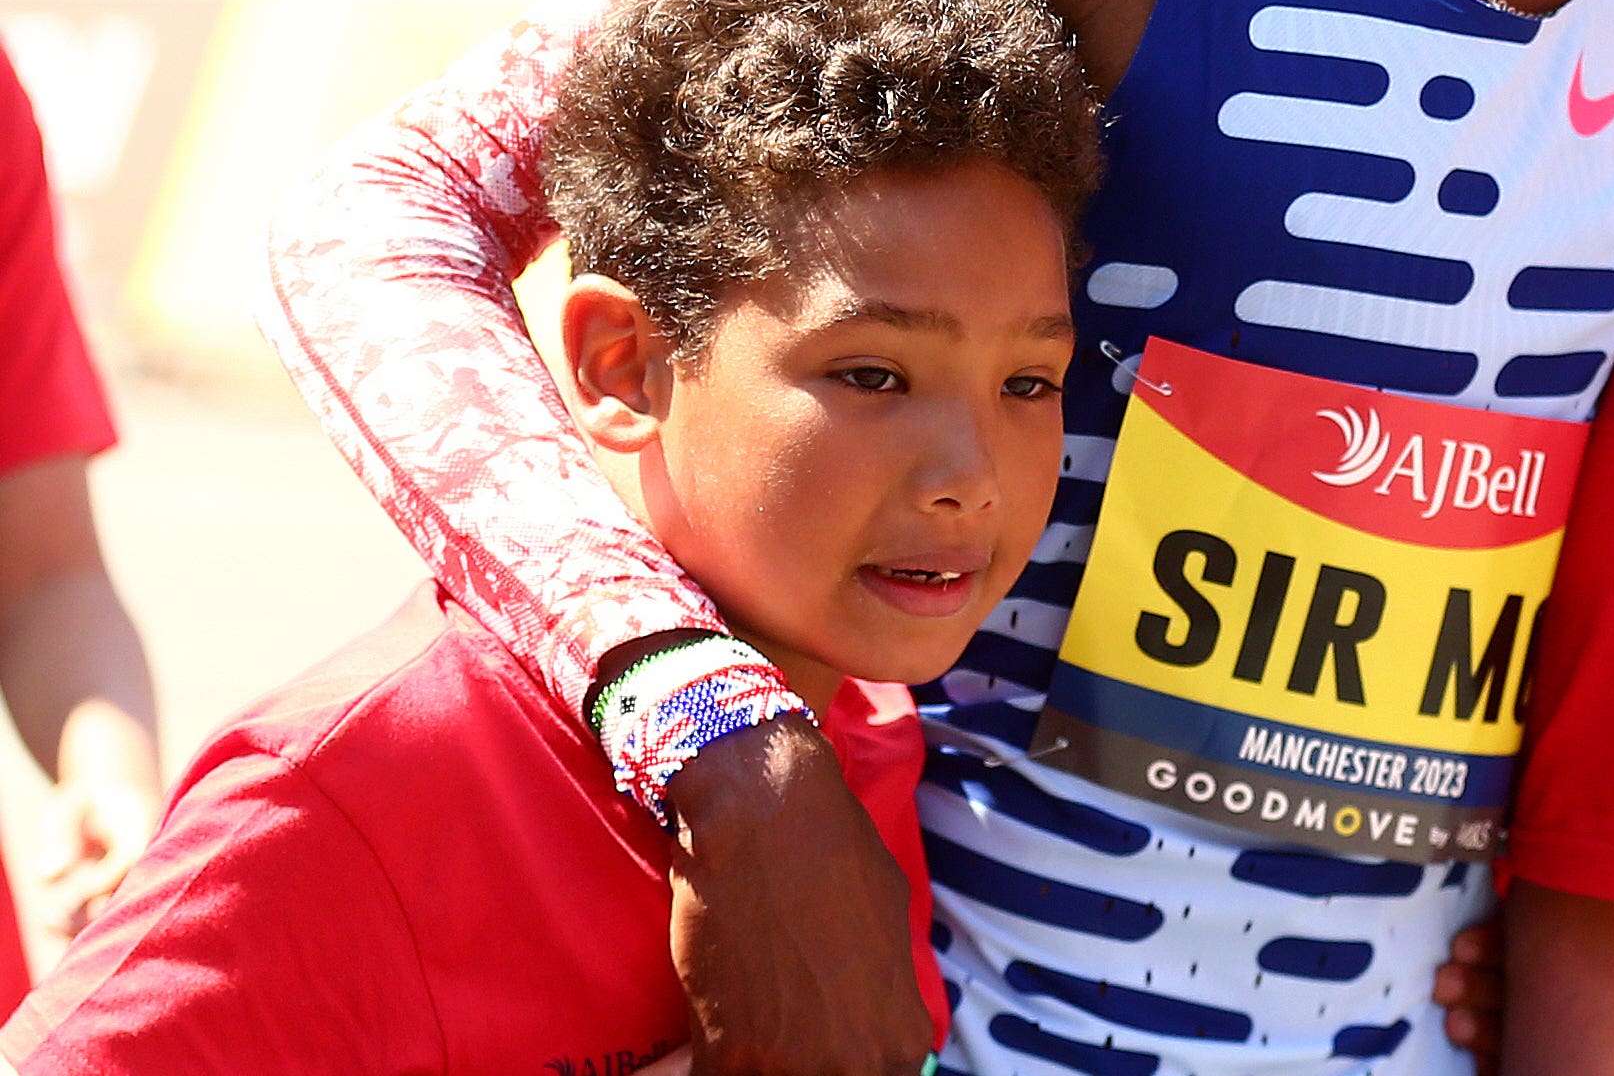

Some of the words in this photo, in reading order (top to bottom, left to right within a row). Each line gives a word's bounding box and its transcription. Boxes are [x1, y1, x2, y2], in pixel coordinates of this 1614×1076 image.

[1374, 434, 1546, 519] AJBell
[1134, 528, 1387, 707] SIR
[1147, 758, 1419, 846] GOODMOVE
[1239, 725, 1408, 790] MANCHESTER
[1409, 757, 1469, 799] 2023
